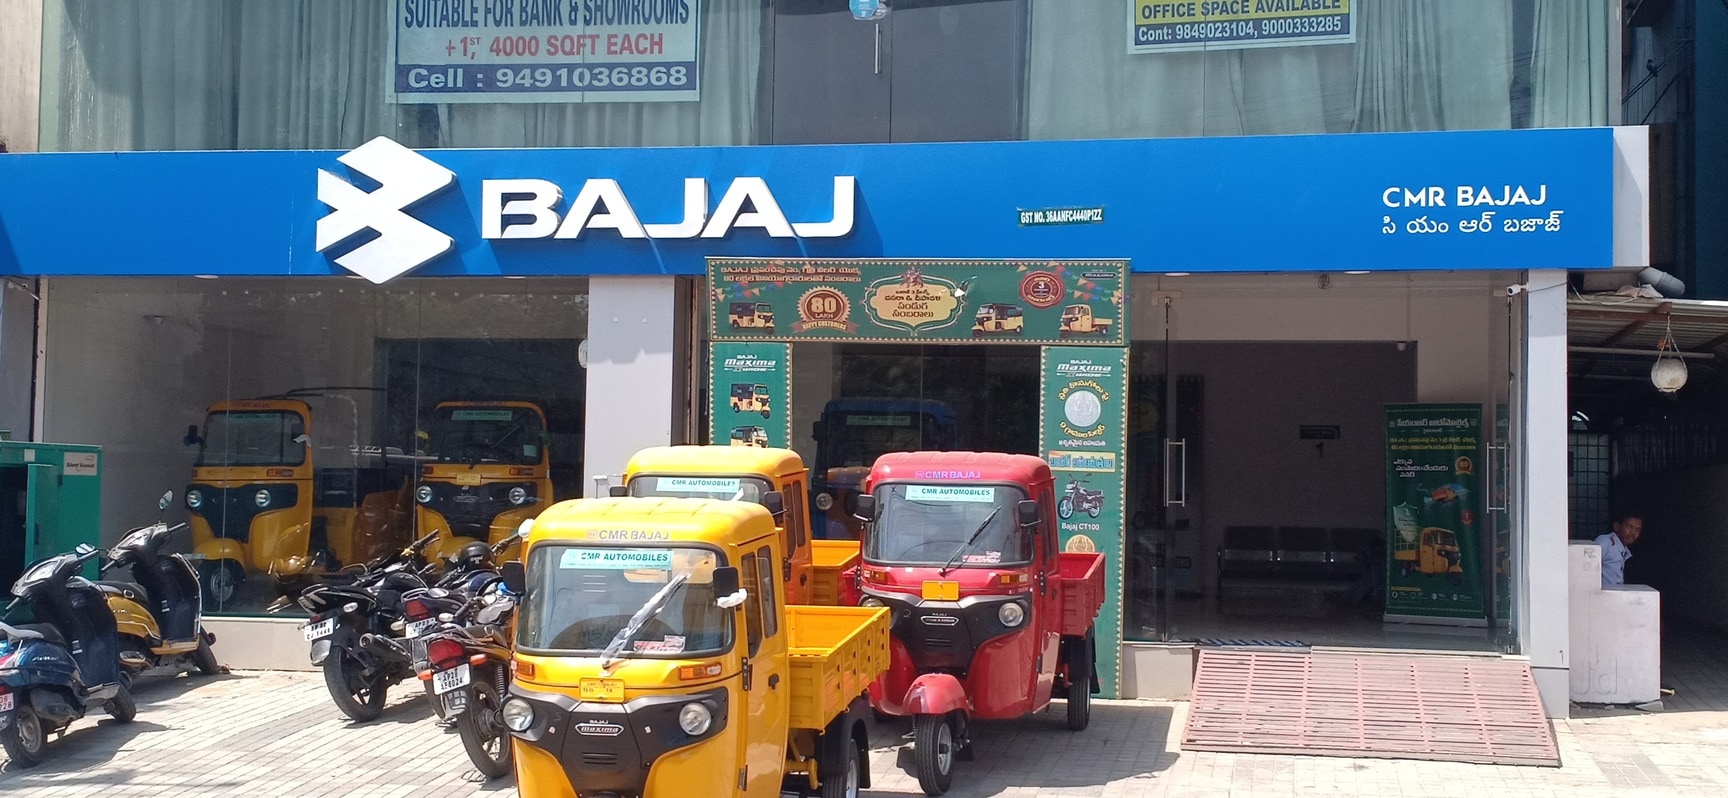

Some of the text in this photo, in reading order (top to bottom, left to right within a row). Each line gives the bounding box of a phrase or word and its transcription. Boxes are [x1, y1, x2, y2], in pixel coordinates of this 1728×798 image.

[404, 0, 689, 28] SUITABLE FOR BANK & SHOWROOMS
[1141, 0, 1341, 20] OFFICE SPACE AVAILABLE
[1138, 15, 1341, 42] Cont: 9849023104, 9000333285
[489, 35, 540, 57] 4000
[546, 34, 602, 56] SQFT
[606, 33, 664, 55] EACH
[408, 67, 464, 89] Cell
[496, 65, 688, 88] 9491036868
[1382, 184, 1547, 208] CMR BAJAJ
[481, 175, 857, 240] BAJAJ
[1021, 211, 1034, 224] GST
[1034, 210, 1045, 223] NO.
[1459, 210, 1496, 233] ఆర్
[1503, 209, 1564, 233] బజాజ్
[811, 297, 837, 313] 80
[925, 470, 949, 479] CMR
[949, 471, 981, 479] BAJAJ
[939, 488, 991, 496] AUTOMOBILES
[599, 530, 628, 540] CMR
[630, 531, 669, 540] BAJAJ
[1062, 522, 1100, 531] Bajaj CT100
[581, 552, 668, 562] CMR AUTOMOBILES
